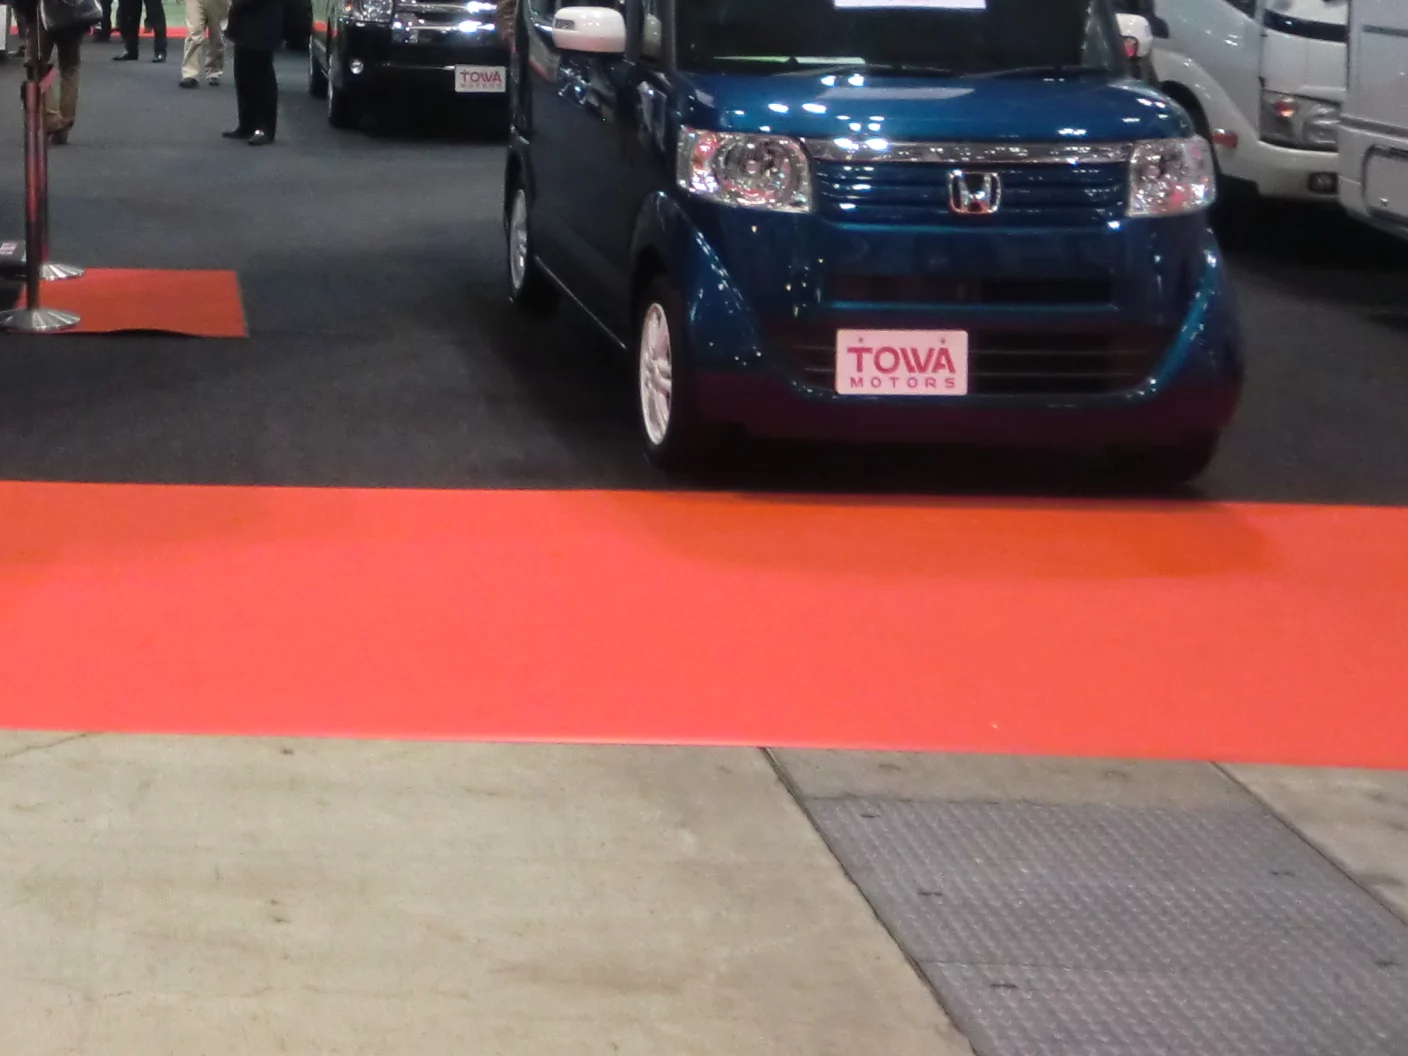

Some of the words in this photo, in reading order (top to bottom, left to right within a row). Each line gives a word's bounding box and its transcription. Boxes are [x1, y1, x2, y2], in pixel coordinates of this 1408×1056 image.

[460, 71, 502, 83] TOWA
[847, 346, 956, 374] TOWA
[850, 377, 956, 389] MOTORS
